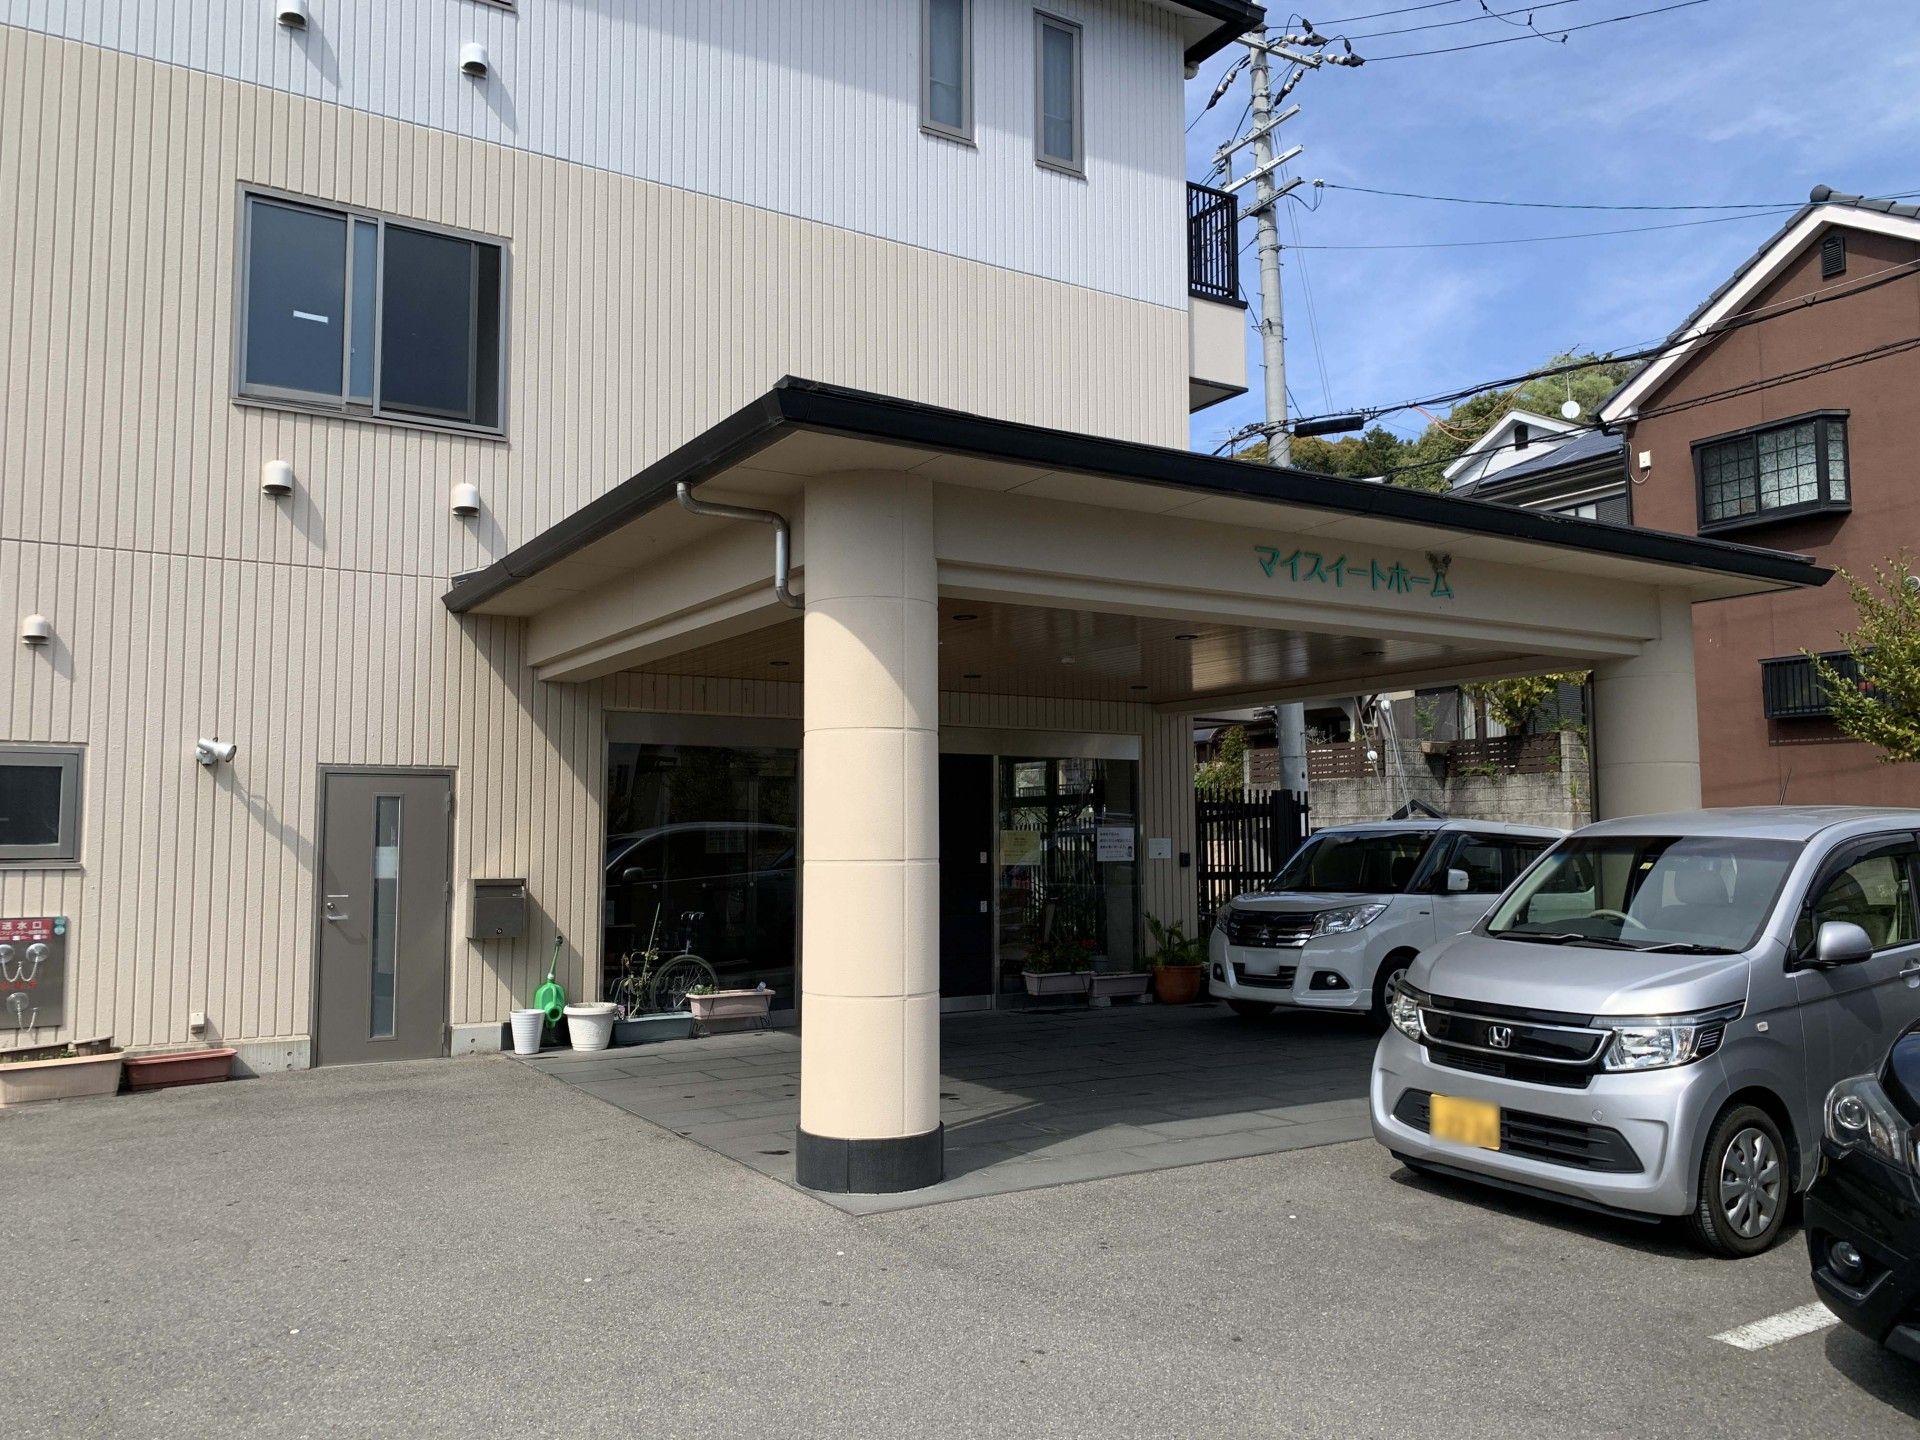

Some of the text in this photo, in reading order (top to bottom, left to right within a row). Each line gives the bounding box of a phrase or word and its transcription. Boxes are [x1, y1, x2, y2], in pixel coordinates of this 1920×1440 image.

[1254, 546, 1455, 599] マイスイートホーム
